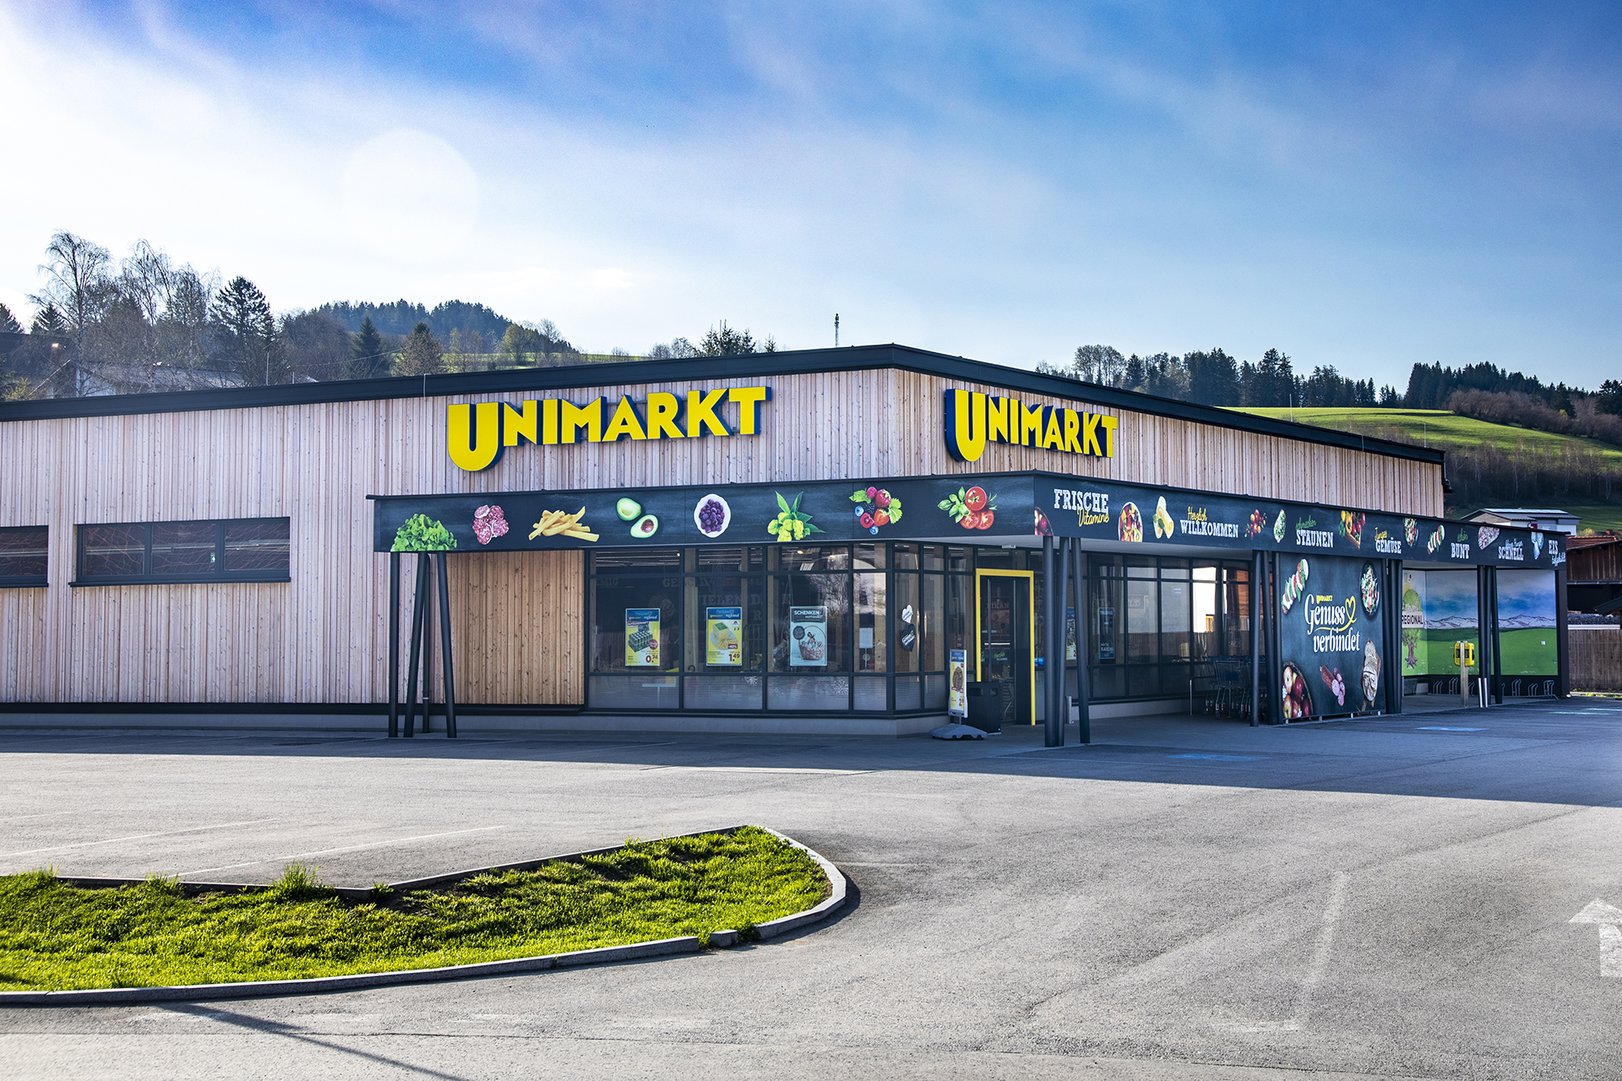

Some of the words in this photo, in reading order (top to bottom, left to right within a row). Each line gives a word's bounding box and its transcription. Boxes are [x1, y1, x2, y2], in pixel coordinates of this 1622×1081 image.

[447, 385, 768, 472] UNIMARKT
[951, 389, 1119, 463] UNIMARKT
[1053, 488, 1109, 514] FRISCHE
[1180, 519, 1239, 538] WILLKOMMEN
[1296, 529, 1334, 548] STAUNEN
[1375, 536, 1402, 554] GEMÜSE
[1451, 543, 1470, 559] BUNT
[1498, 546, 1525, 561] SCHNELL
[1305, 593, 1346, 635] Genuss
[1313, 627, 1361, 653] verbindet
